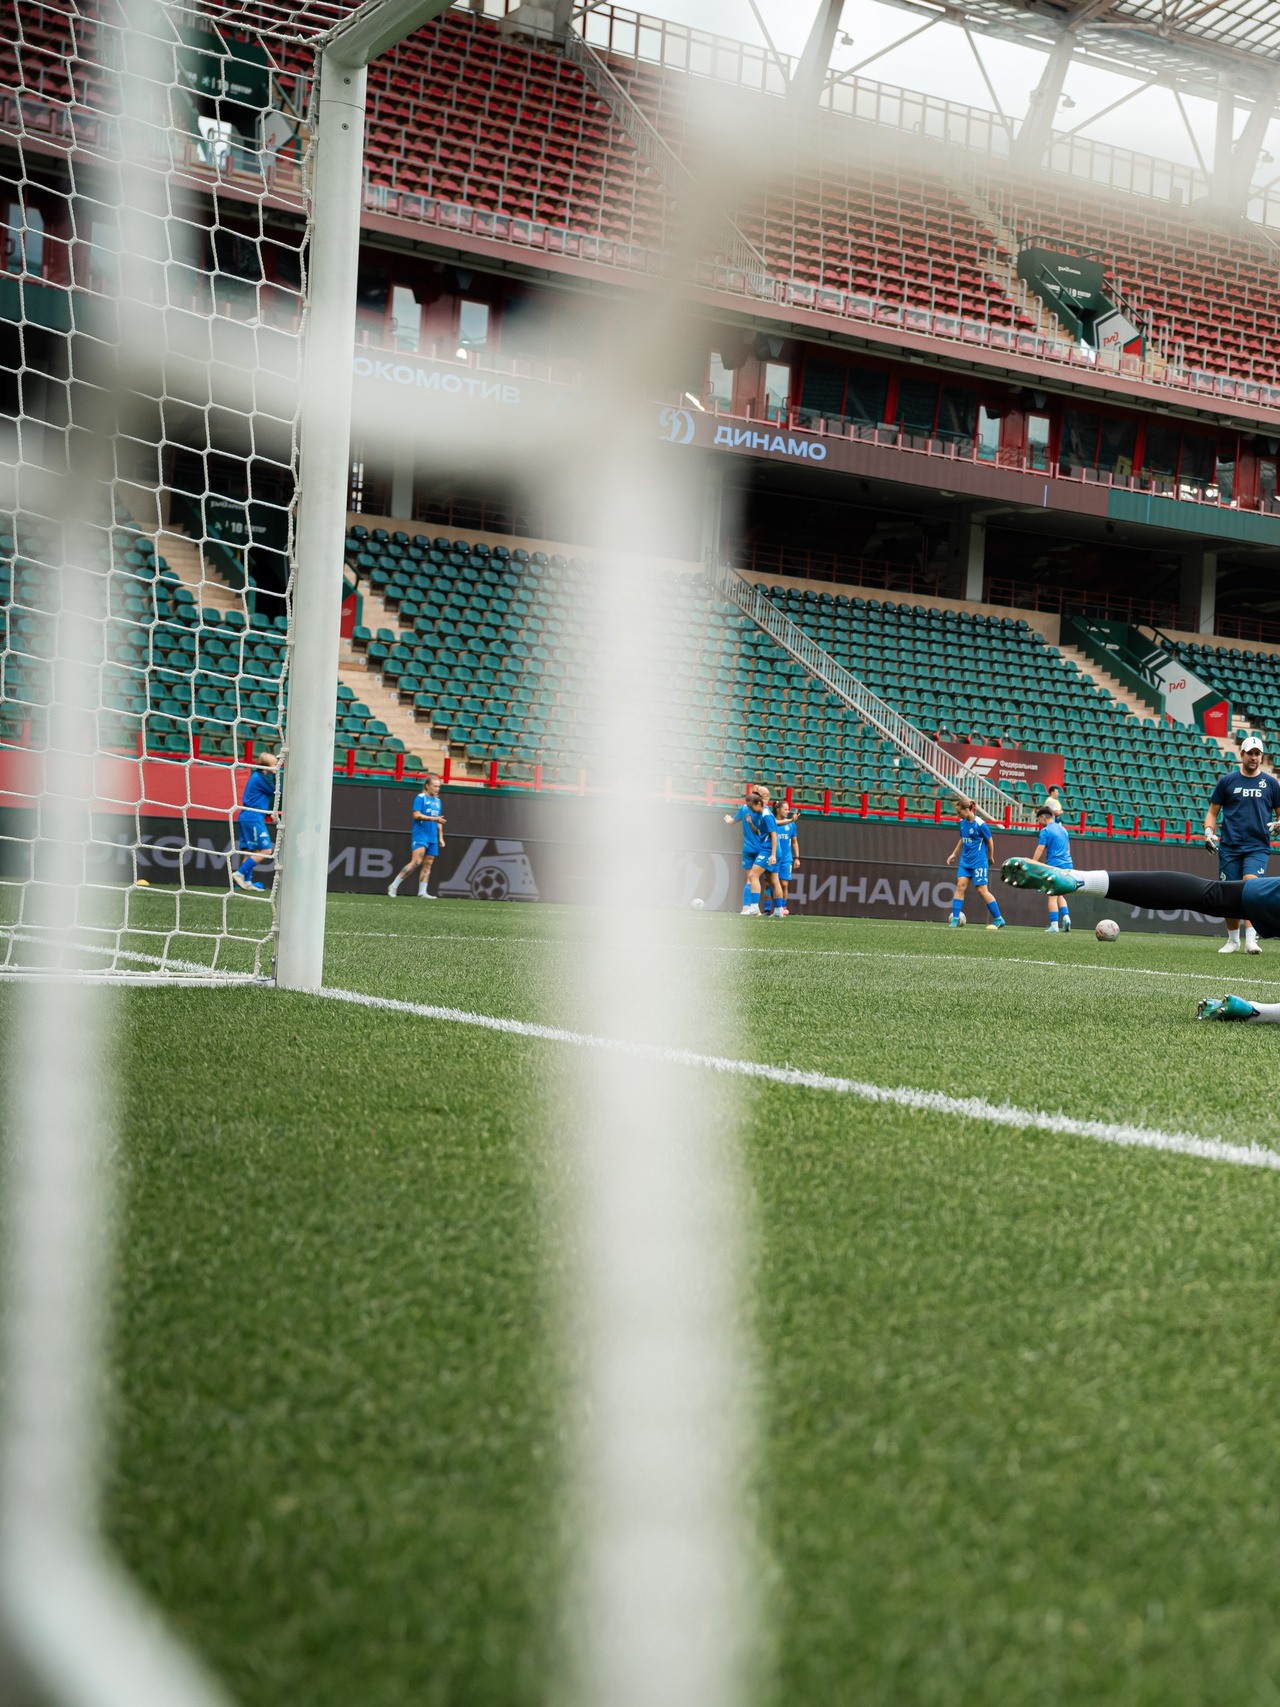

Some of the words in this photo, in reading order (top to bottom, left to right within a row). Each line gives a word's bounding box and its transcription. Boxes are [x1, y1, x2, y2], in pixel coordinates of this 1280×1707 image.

[353, 357, 521, 404] ОКОМОТИВ
[714, 425, 827, 461] ДИНАМО
[231, 521, 243, 534] 10
[1242, 788, 1262, 798] ВТБ
[787, 872, 957, 909] ДИНАМО
